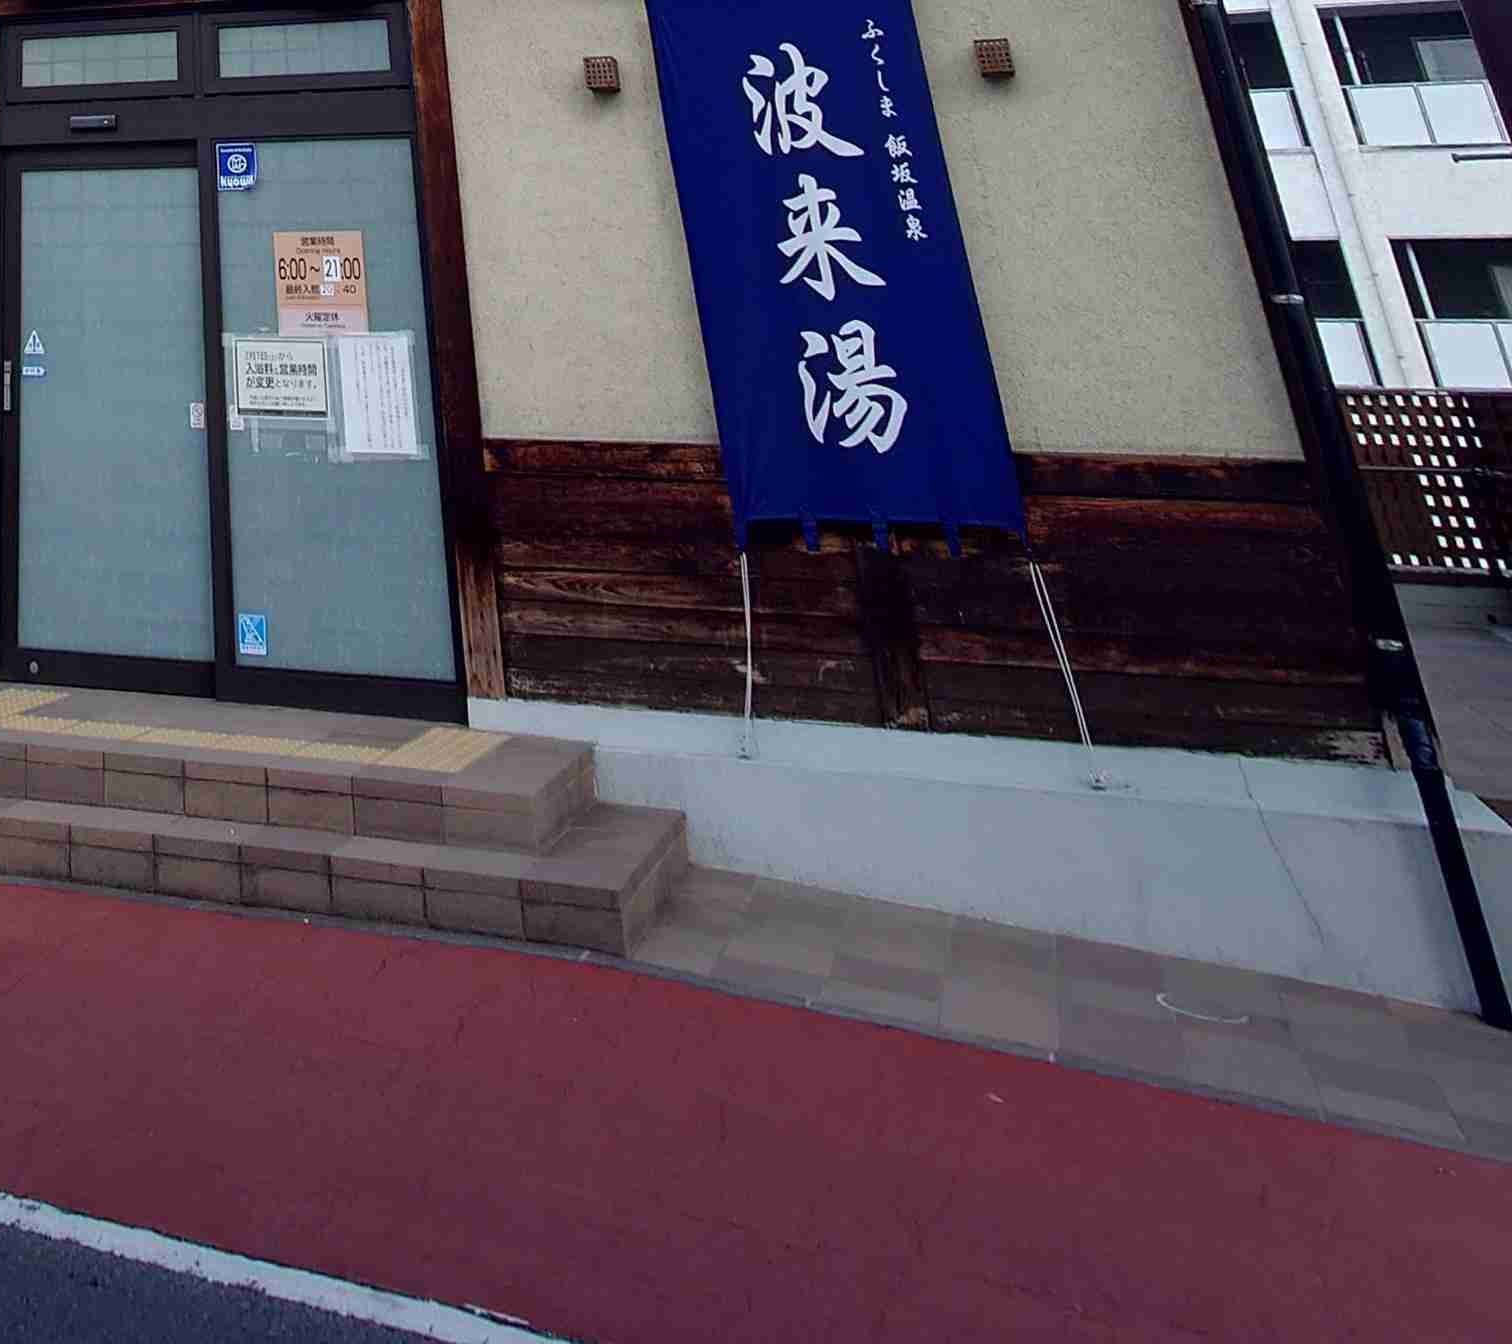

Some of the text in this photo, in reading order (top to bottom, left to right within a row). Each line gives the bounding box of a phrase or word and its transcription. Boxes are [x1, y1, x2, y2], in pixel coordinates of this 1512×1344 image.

[741, 41, 909, 454] 波来湯
[884, 134, 929, 242] 飯坂温泉
